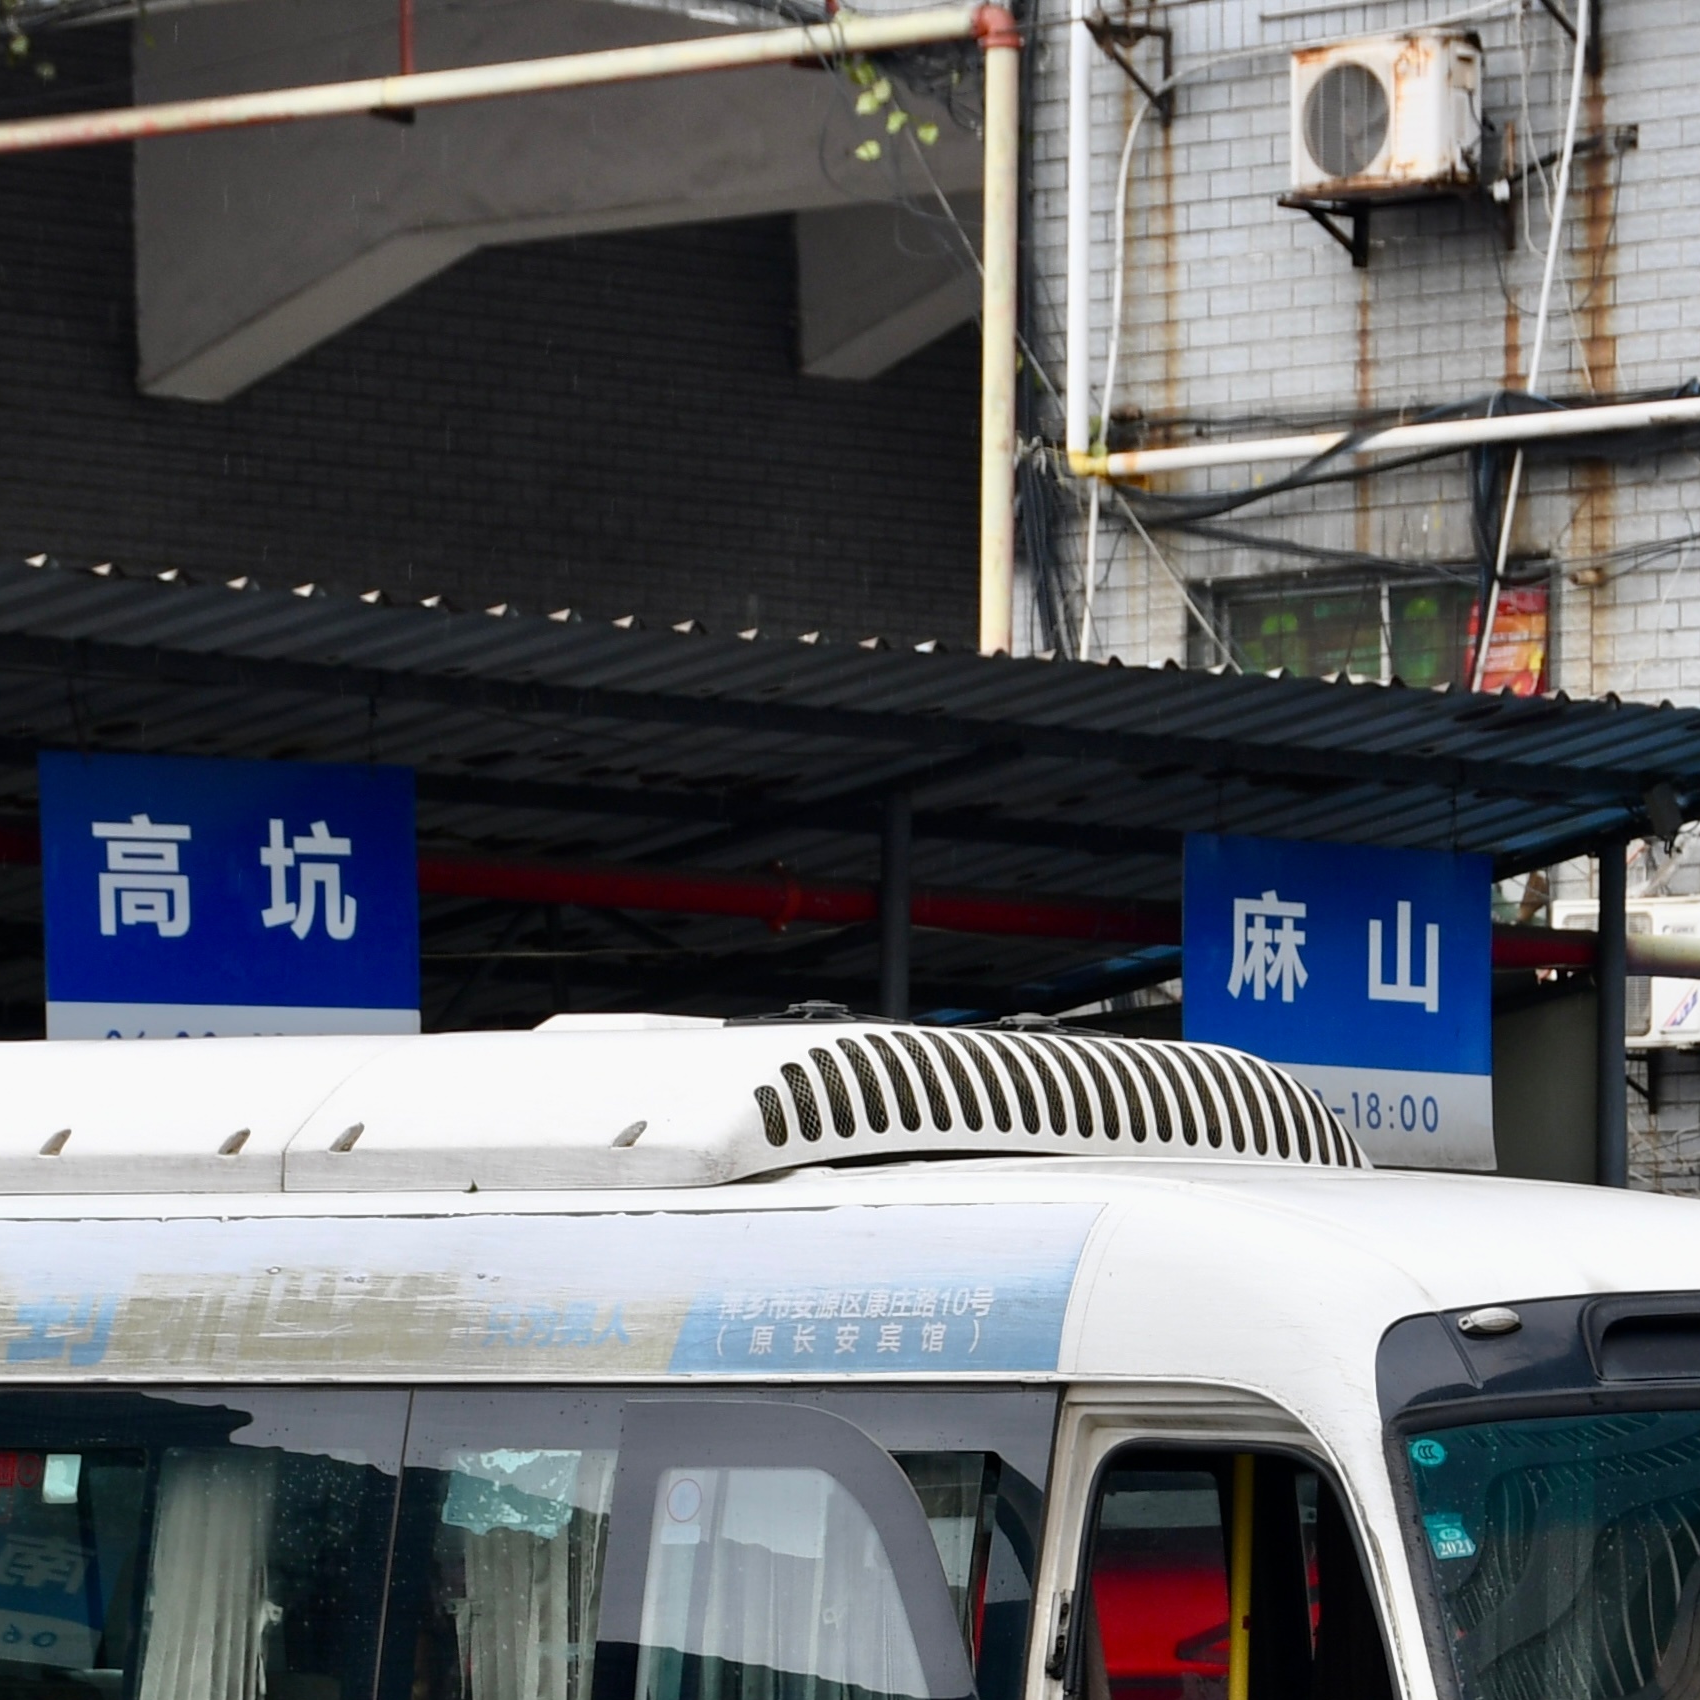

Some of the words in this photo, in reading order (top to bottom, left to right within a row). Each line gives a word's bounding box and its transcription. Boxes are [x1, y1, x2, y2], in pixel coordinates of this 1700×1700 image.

[91, 813, 357, 941] 高坑
[1227, 889, 1440, 1013] 麻山
[1313, 1088, 1439, 1133] -18:00
[717, 1286, 995, 1321] 萍乡市安源区康庄路10号
[1437, 1539, 1474, 1556] 2021
